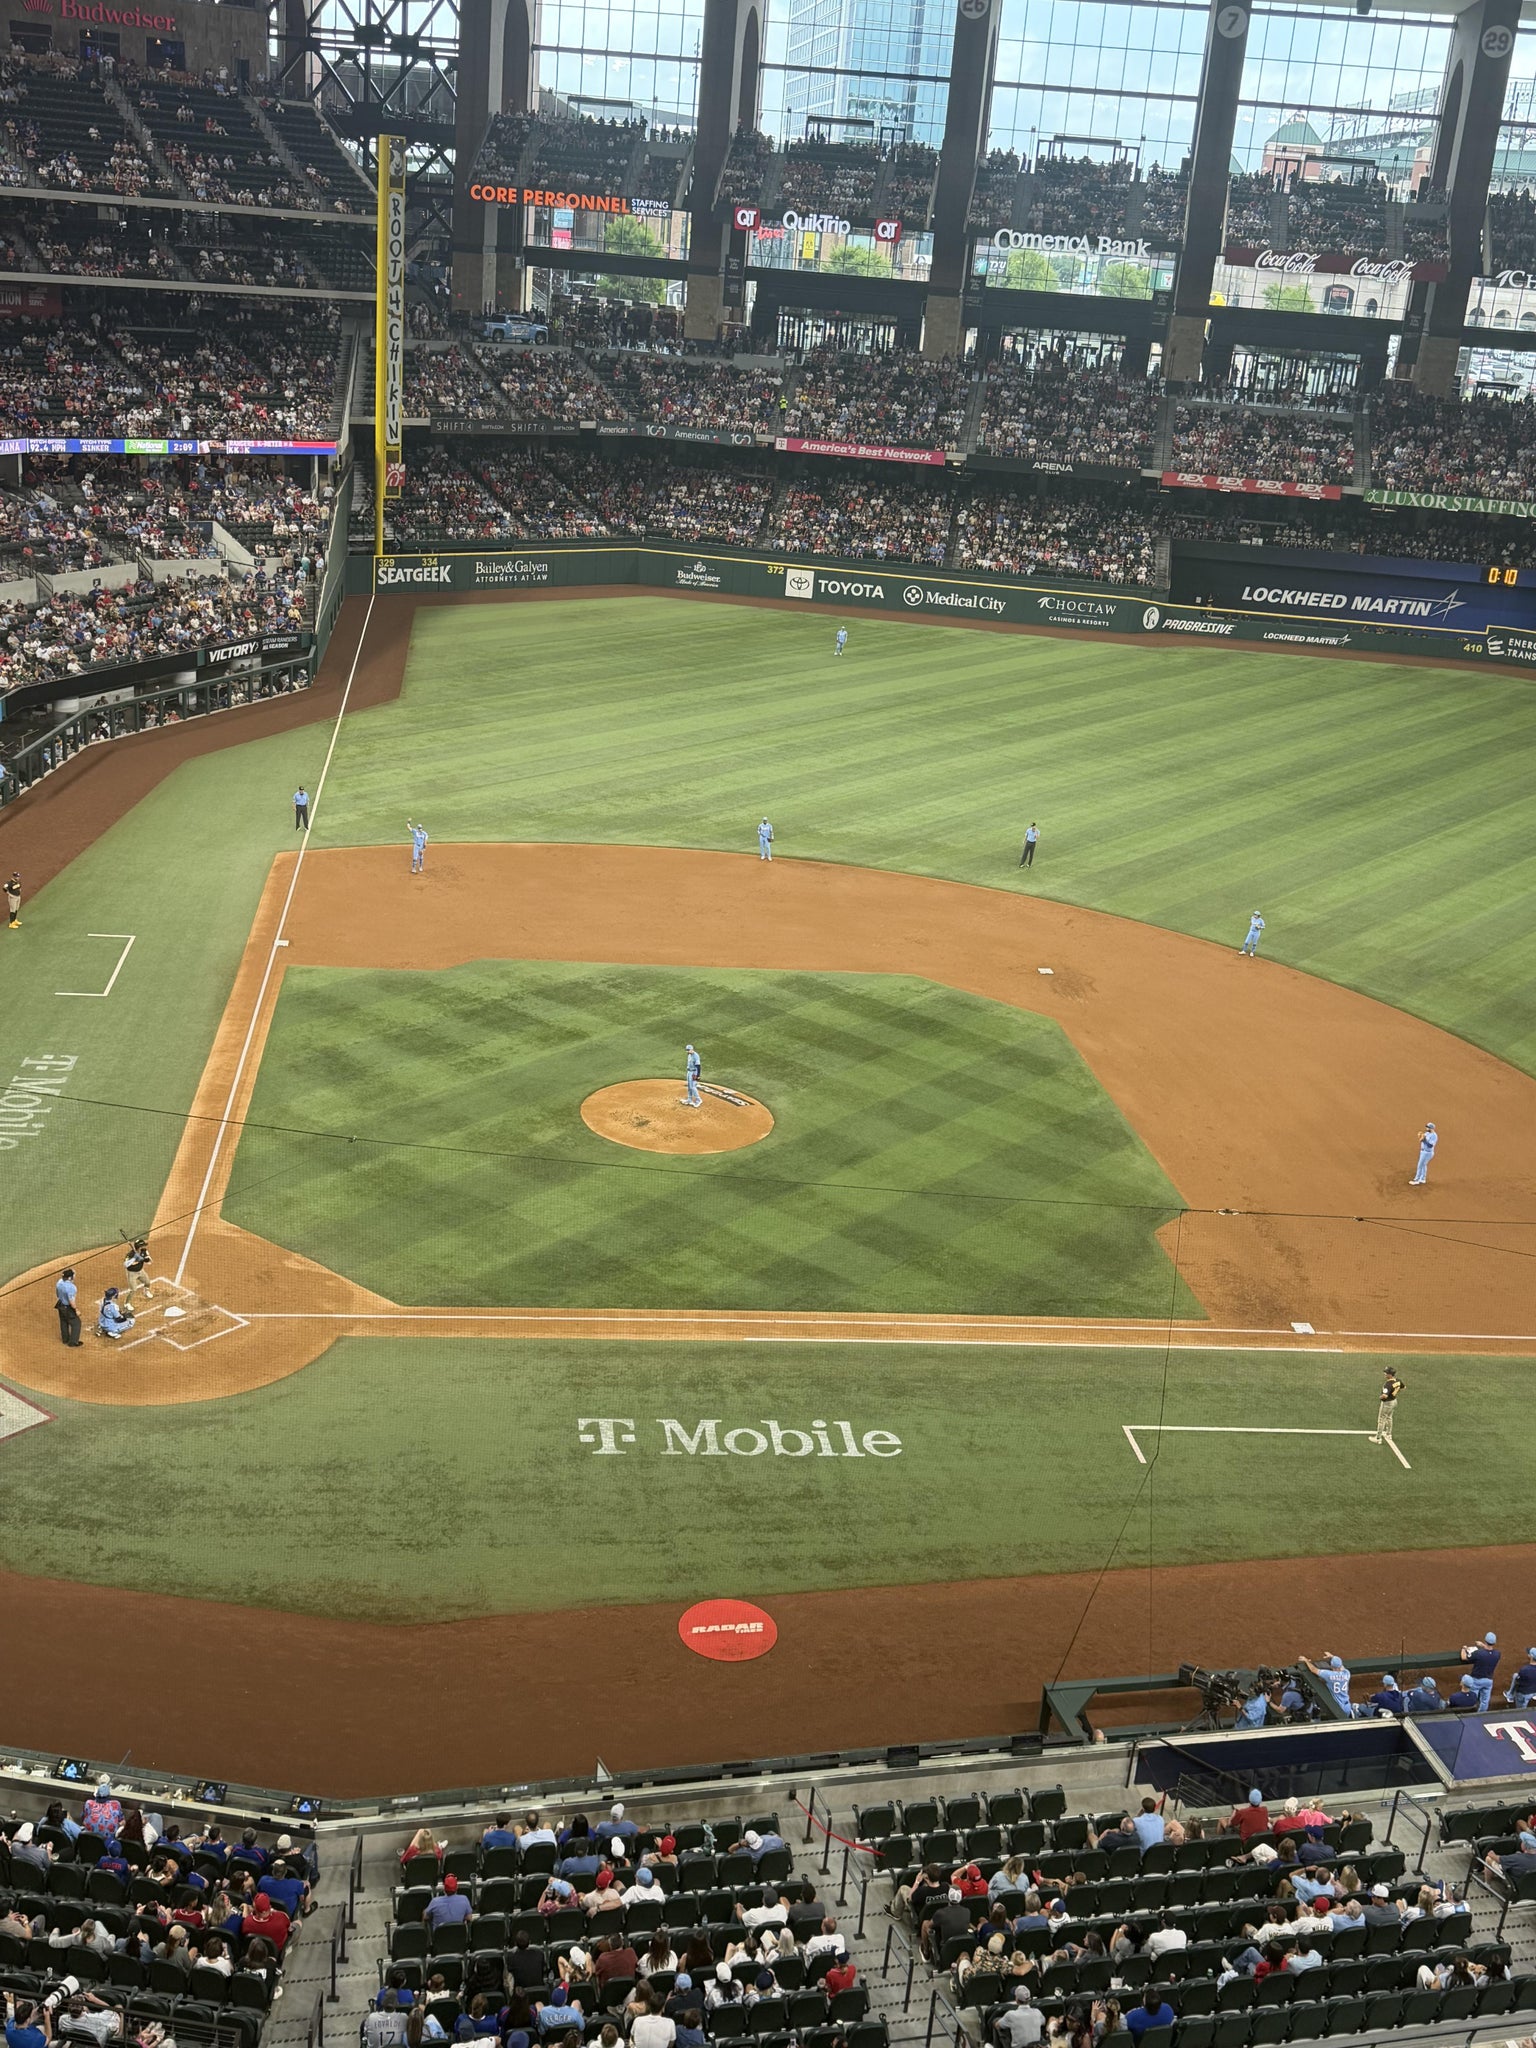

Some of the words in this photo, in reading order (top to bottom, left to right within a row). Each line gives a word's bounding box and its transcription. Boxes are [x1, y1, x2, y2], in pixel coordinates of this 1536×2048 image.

[61, 0, 175, 31] Budweiser
[1224, 13, 1239, 31] 7
[1485, 31, 1509, 51] 29
[470, 184, 517, 204] CORE
[523, 189, 630, 214] PERSONNEL
[631, 198, 669, 209] STAFFING
[632, 206, 668, 217] SERVICES
[736, 209, 757, 227] QT
[782, 210, 851, 237] QuikTrip
[877, 221, 898, 240] QT
[390, 198, 402, 278] ROOT
[1097, 235, 1152, 257] Bank
[1254, 250, 1321, 274] Coca-Cola
[1350, 257, 1417, 281] Coca-Cola
[390, 290, 401, 311] 4
[599, 426, 629, 434] American
[675, 430, 710, 441] American
[30, 444, 49, 452] 92.4
[82, 444, 110, 452] SINKER
[801, 441, 856, 454] America's
[858, 446, 883, 457] Best
[884, 448, 932, 461] Network
[1032, 461, 1073, 472] ARENA
[1177, 473, 1206, 483] DEX
[1216, 477, 1246, 486] DEX
[1256, 480, 1285, 489] DEX
[1295, 483, 1324, 493] DEX
[1382, 491, 1447, 509] LUXOR
[378, 558, 395, 567] 329
[422, 557, 438, 567] 334
[767, 566, 785, 575] 372
[378, 564, 452, 585] SEATGEEK
[475, 575, 518, 583] ATTORNEYS
[676, 570, 721, 583] Budweiser
[1488, 567, 1519, 586] 0:10
[818, 579, 885, 599] TOYOTA
[926, 591, 977, 609] Medical
[978, 596, 1007, 614] City
[1044, 597, 1117, 615] CHOCTAW
[1242, 586, 1348, 609] LOCKHEED
[1350, 596, 1433, 617] MARTIN
[1048, 616, 1076, 624] CASINOS
[1082, 619, 1110, 627] RESORTS
[1162, 618, 1235, 635] PROGRESSIVE
[1263, 632, 1305, 642] LOCKHEED
[1306, 636, 1339, 645] MARTIN
[209, 641, 256, 663] VICTORY
[1463, 643, 1483, 653] 410
[656, 1418, 903, 1457] Mobile
[1333, 1681, 1349, 1693] 64
[380, 2031, 395, 2047] 17
